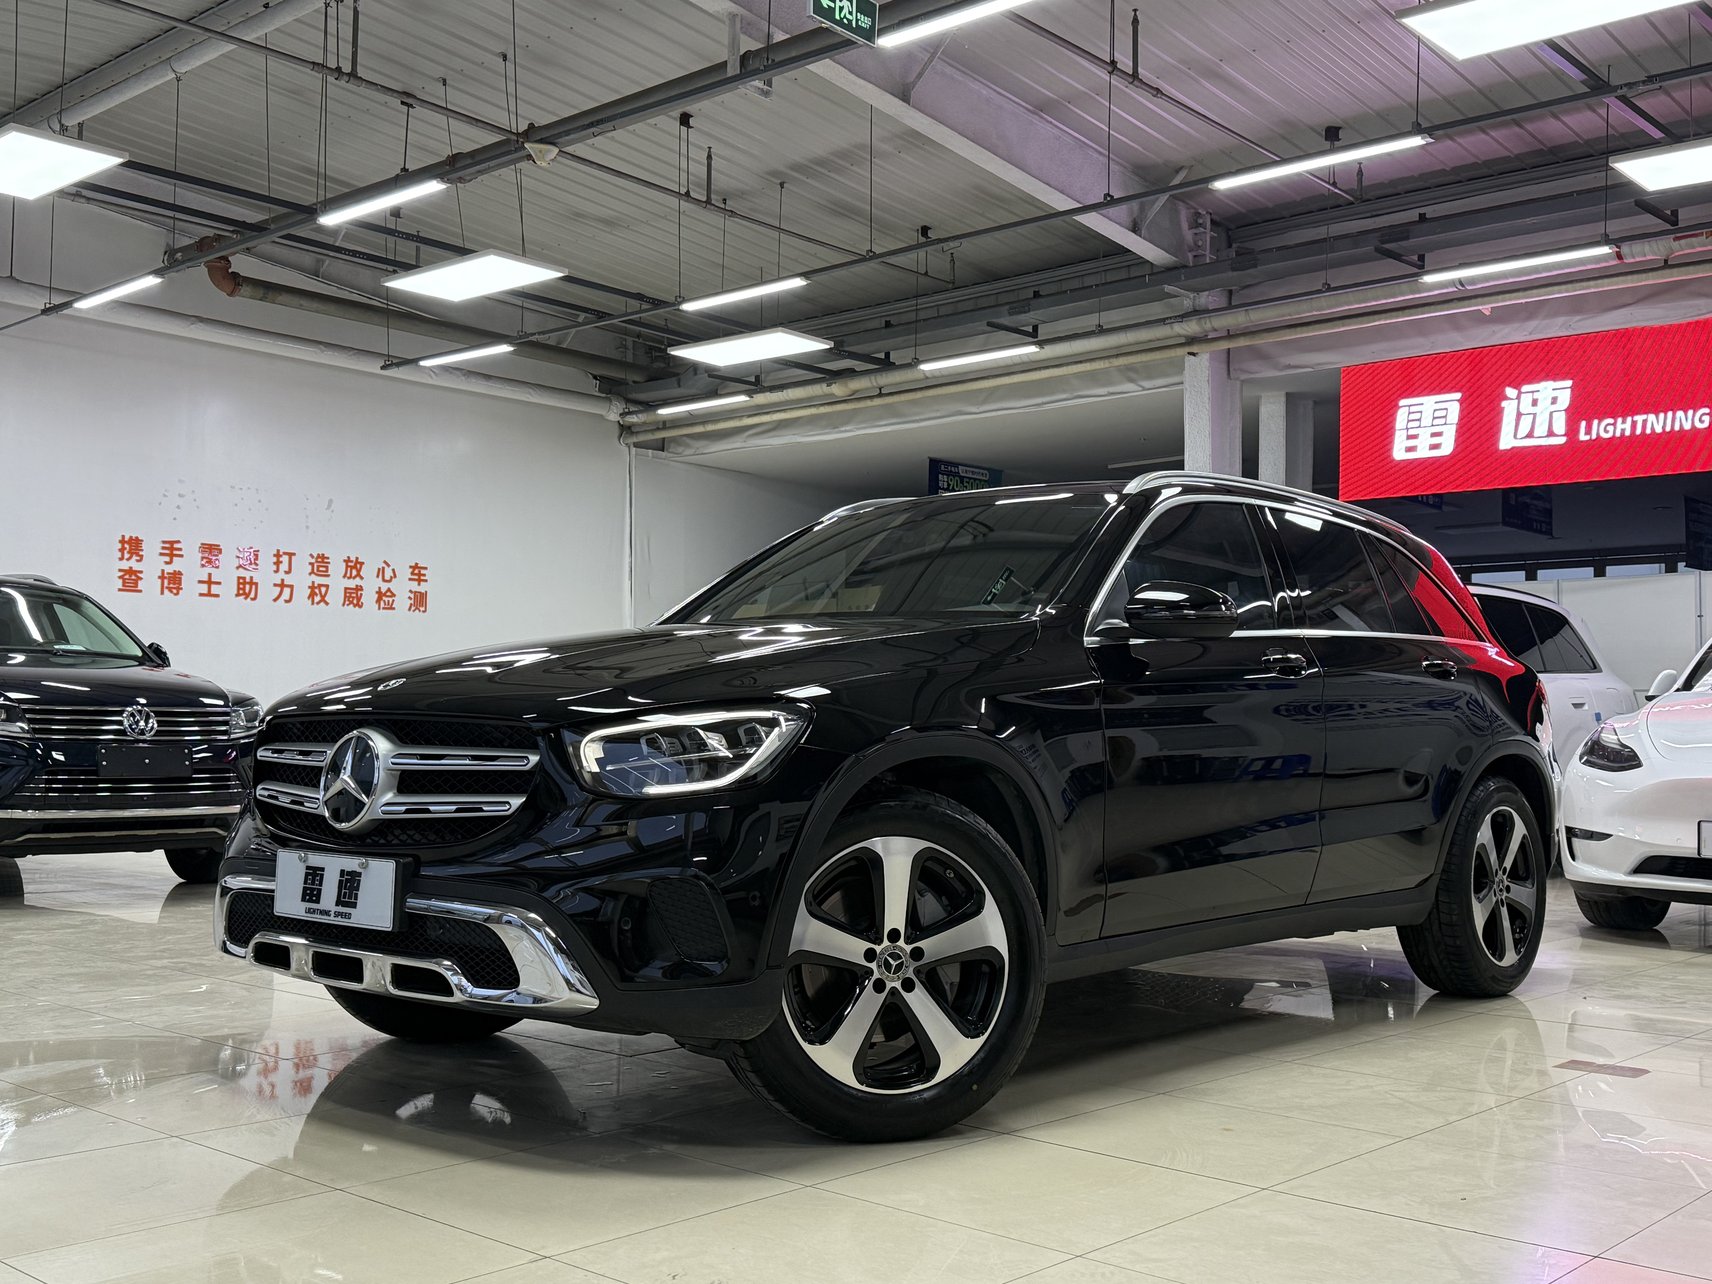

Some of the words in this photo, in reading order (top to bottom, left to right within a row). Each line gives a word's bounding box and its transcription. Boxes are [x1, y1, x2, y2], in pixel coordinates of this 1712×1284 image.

[1392, 379, 1573, 461] 雷速
[1579, 407, 1711, 441] LIGHTNING
[117, 566, 428, 613] 查博士助力权威检测
[300, 865, 363, 909] 雷速
[305, 907, 332, 917] LIGHTNING
[333, 911, 352, 920] SPEED
